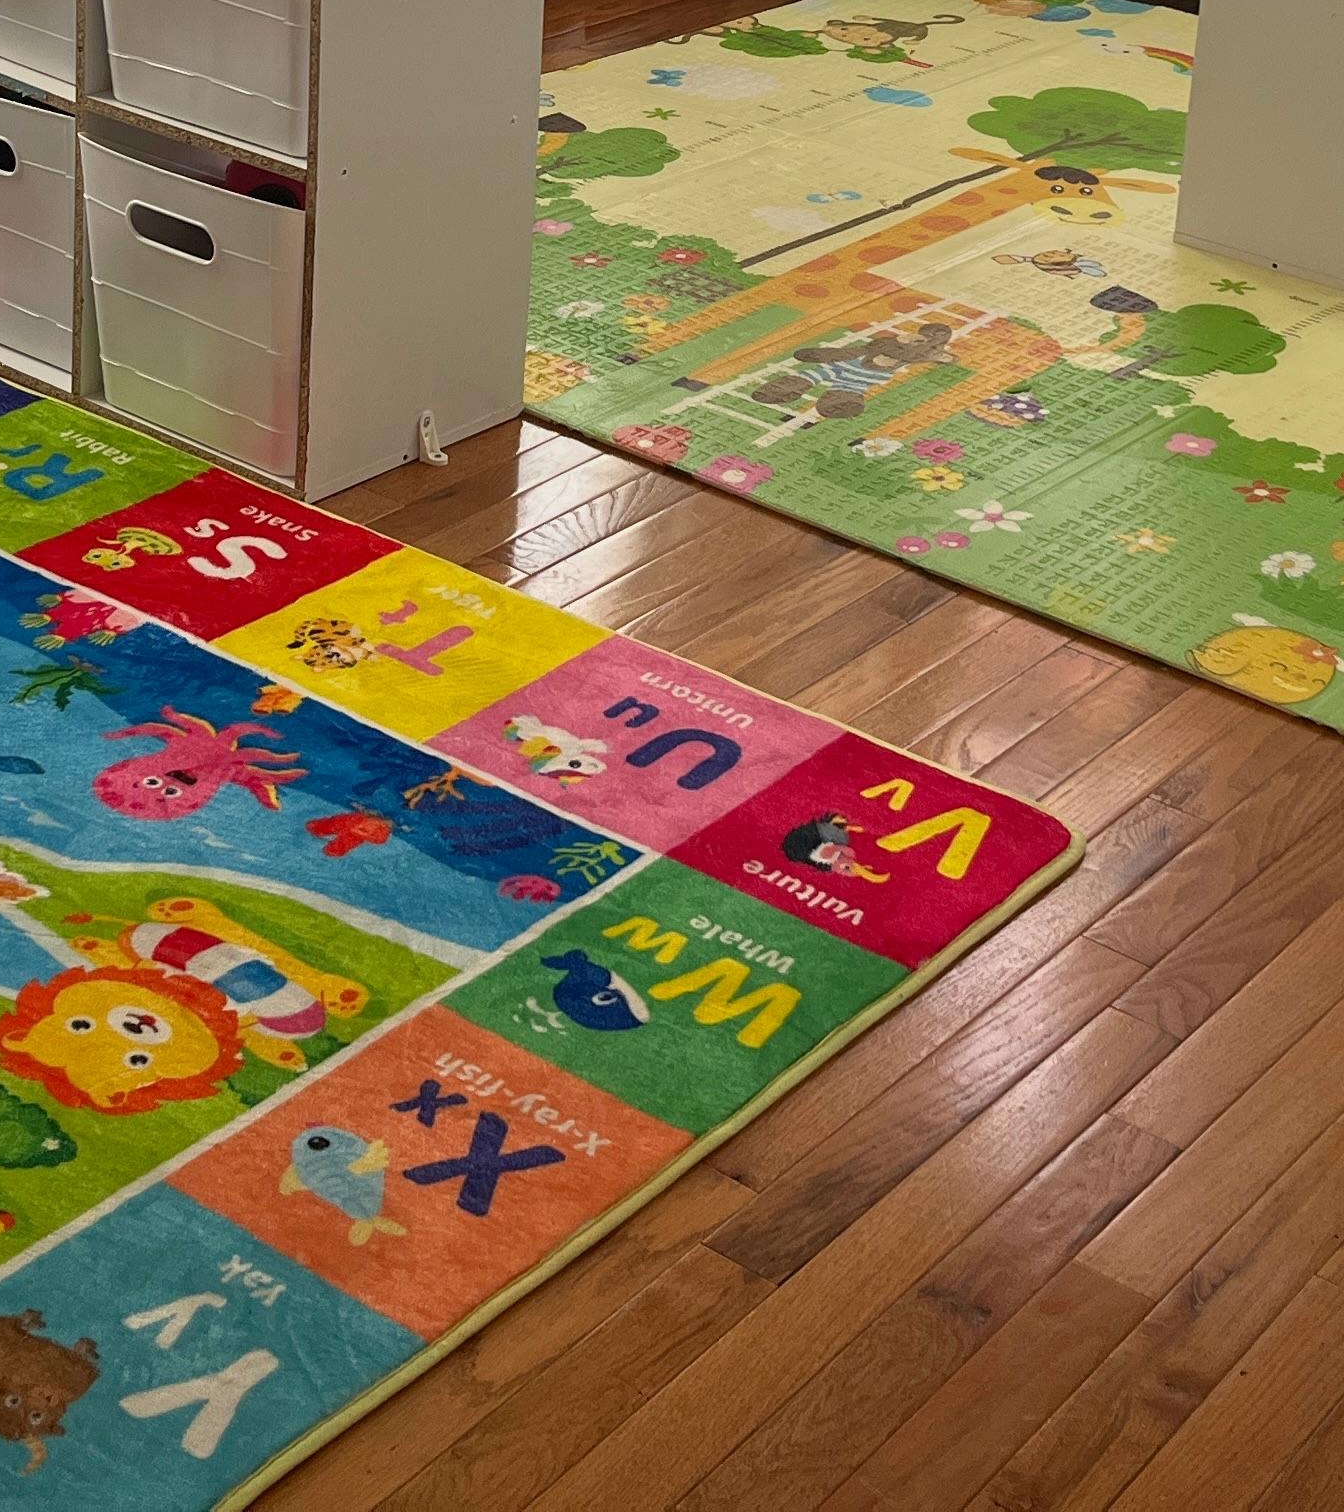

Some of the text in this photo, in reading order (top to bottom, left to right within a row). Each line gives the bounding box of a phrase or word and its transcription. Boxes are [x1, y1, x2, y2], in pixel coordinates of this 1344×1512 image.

[59, 429, 137, 467] Rabbit
[182, 517, 289, 581] Ss
[239, 503, 320, 543] Snake
[374, 599, 476, 677] Tt
[639, 671, 754, 730] Unicorn
[602, 695, 743, 791] Uu
[859, 777, 992, 881] Vv
[741, 857, 866, 927] Vulture
[688, 913, 796, 976] Whale
[601, 915, 802, 1049] Ww
[434, 1051, 614, 1158] X-ray-fish
[389, 1078, 567, 1218] Xx
[217, 1253, 288, 1308] Yak
[118, 1290, 281, 1461] Yy
